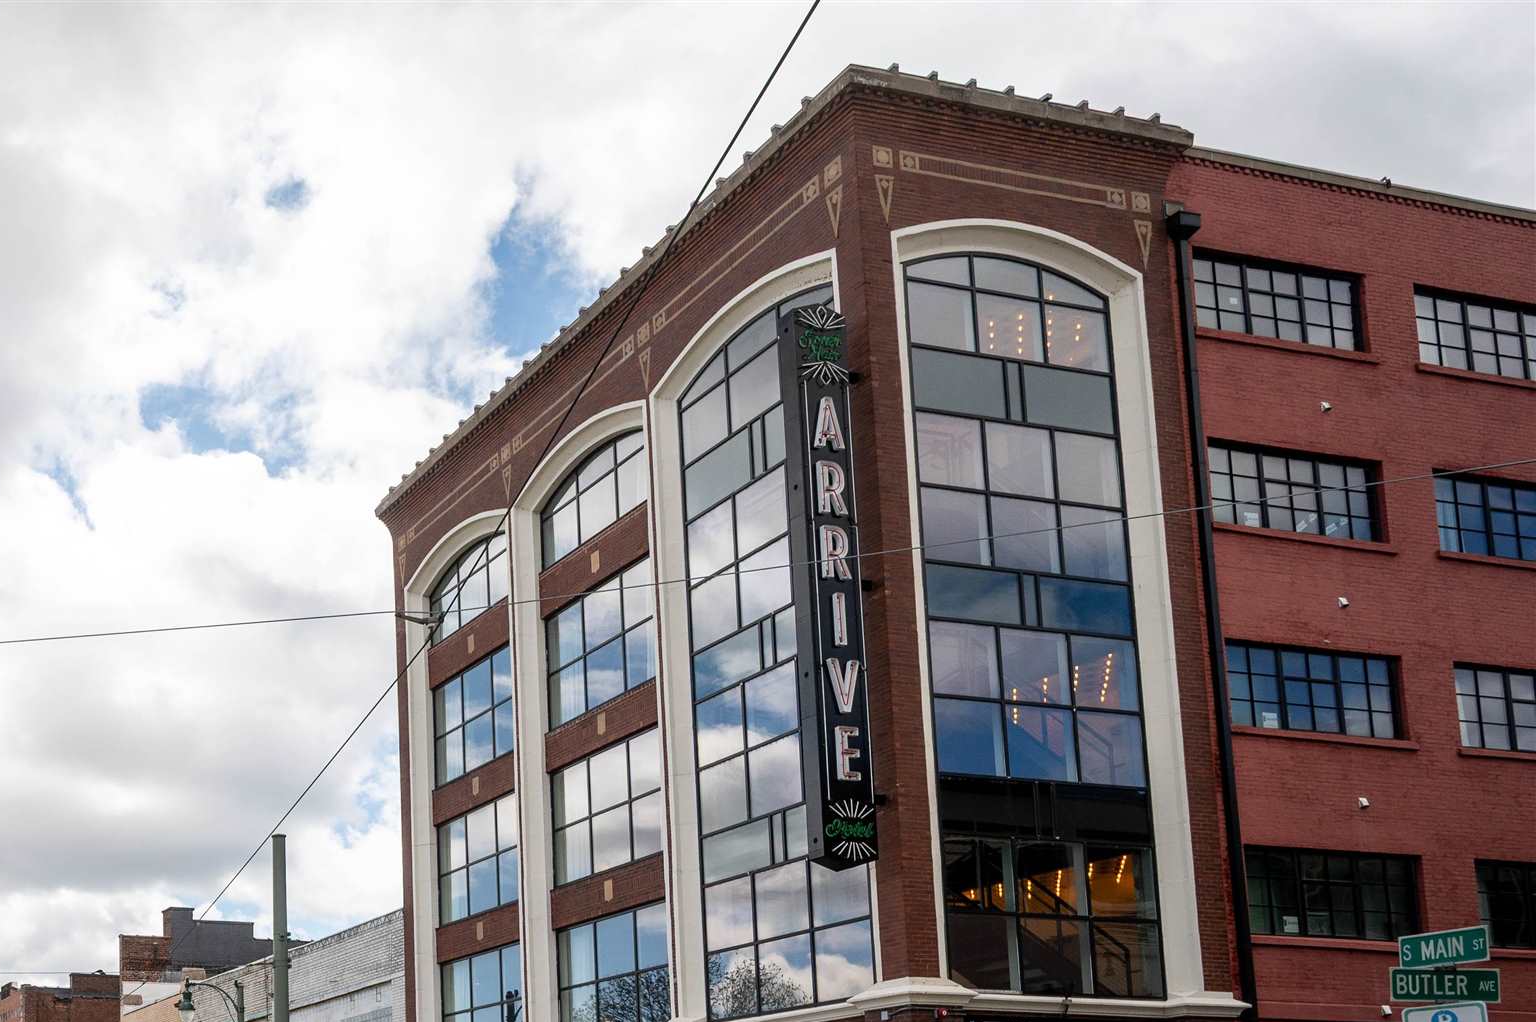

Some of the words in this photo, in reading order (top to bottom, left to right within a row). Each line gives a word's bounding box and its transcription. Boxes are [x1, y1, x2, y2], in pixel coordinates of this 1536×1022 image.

[814, 396, 862, 781] ARRIVE
[1403, 944, 1412, 961] S
[1420, 936, 1464, 960] MAIN
[1472, 938, 1484, 951] ST
[1396, 974, 1468, 996] BUTLER
[1478, 981, 1496, 992] AVE
